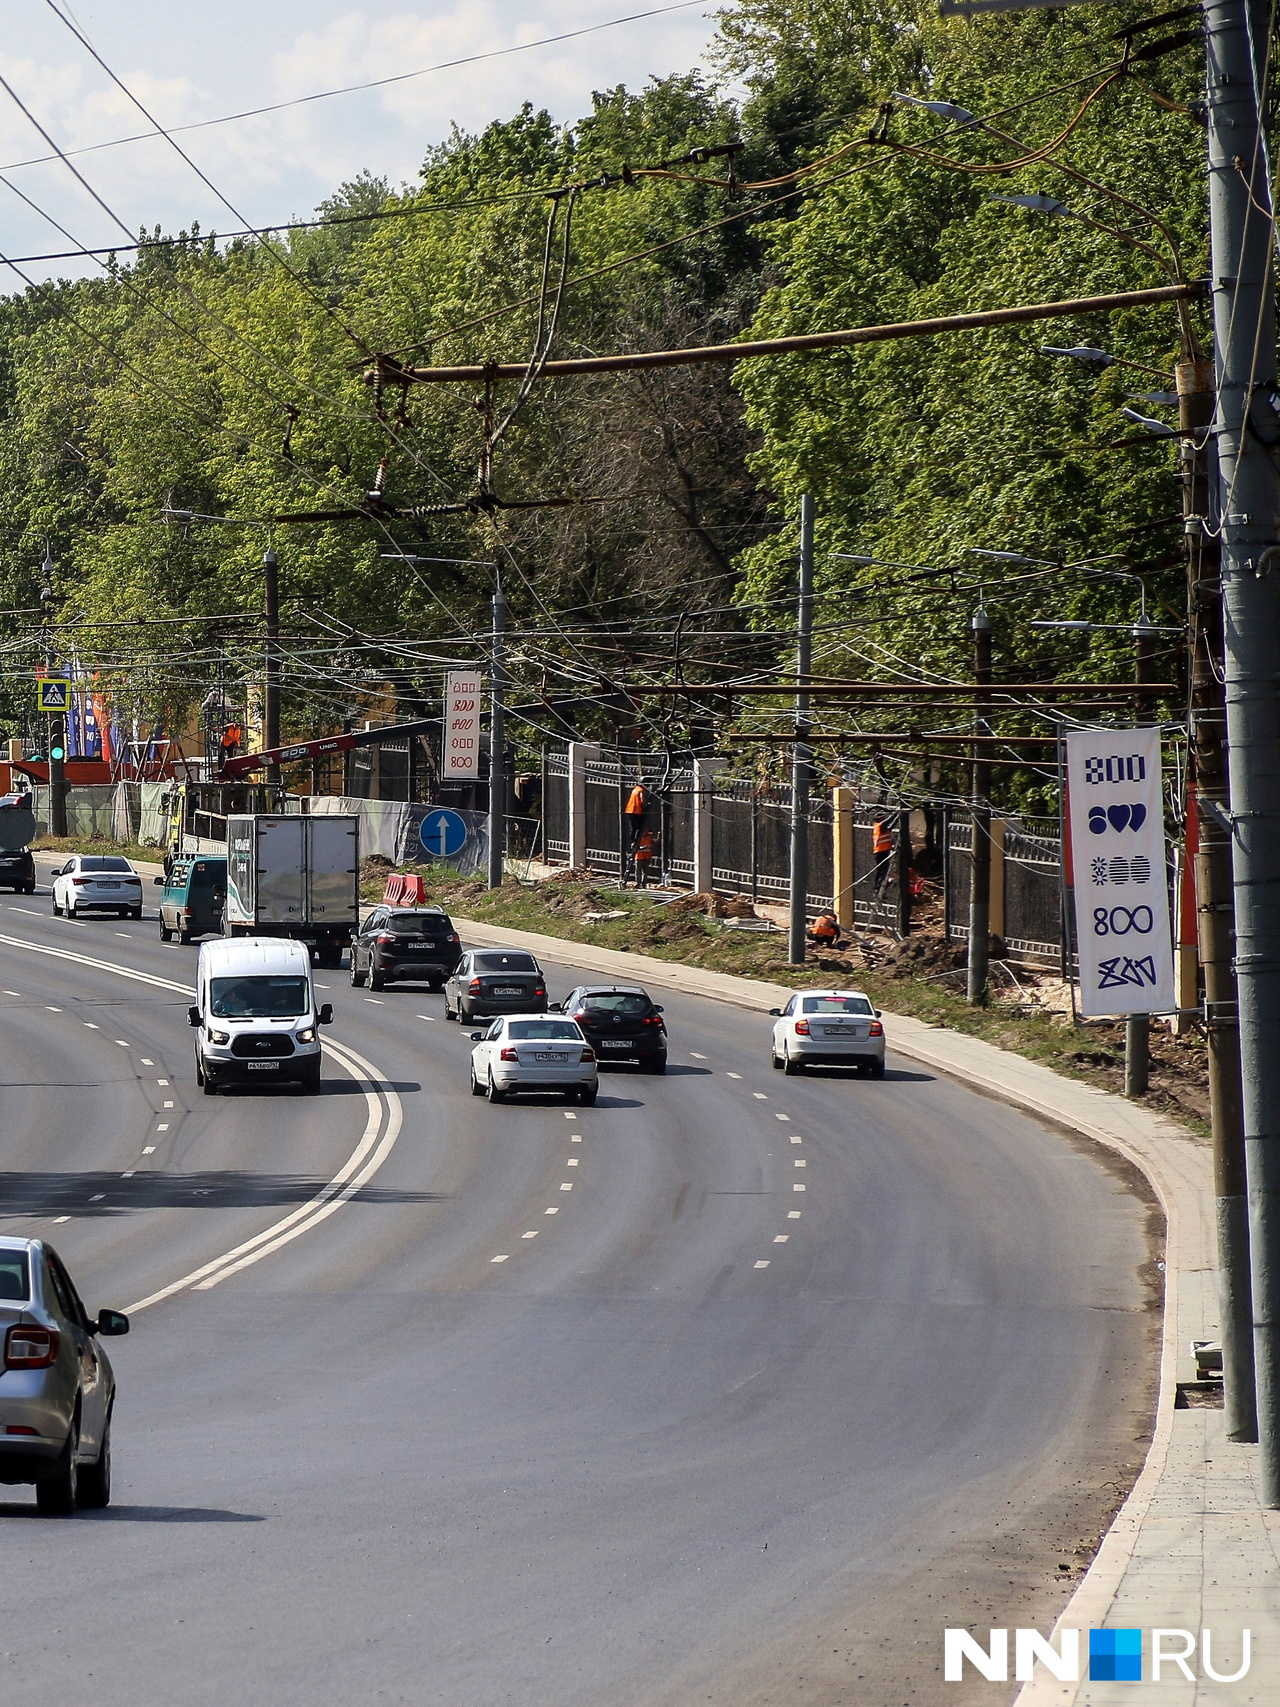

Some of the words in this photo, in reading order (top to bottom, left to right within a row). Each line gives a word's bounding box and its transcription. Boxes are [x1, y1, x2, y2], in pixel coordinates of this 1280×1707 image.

[450, 756, 473, 768] 800
[1085, 754, 1146, 785] 800
[1093, 904, 1154, 936] 800
